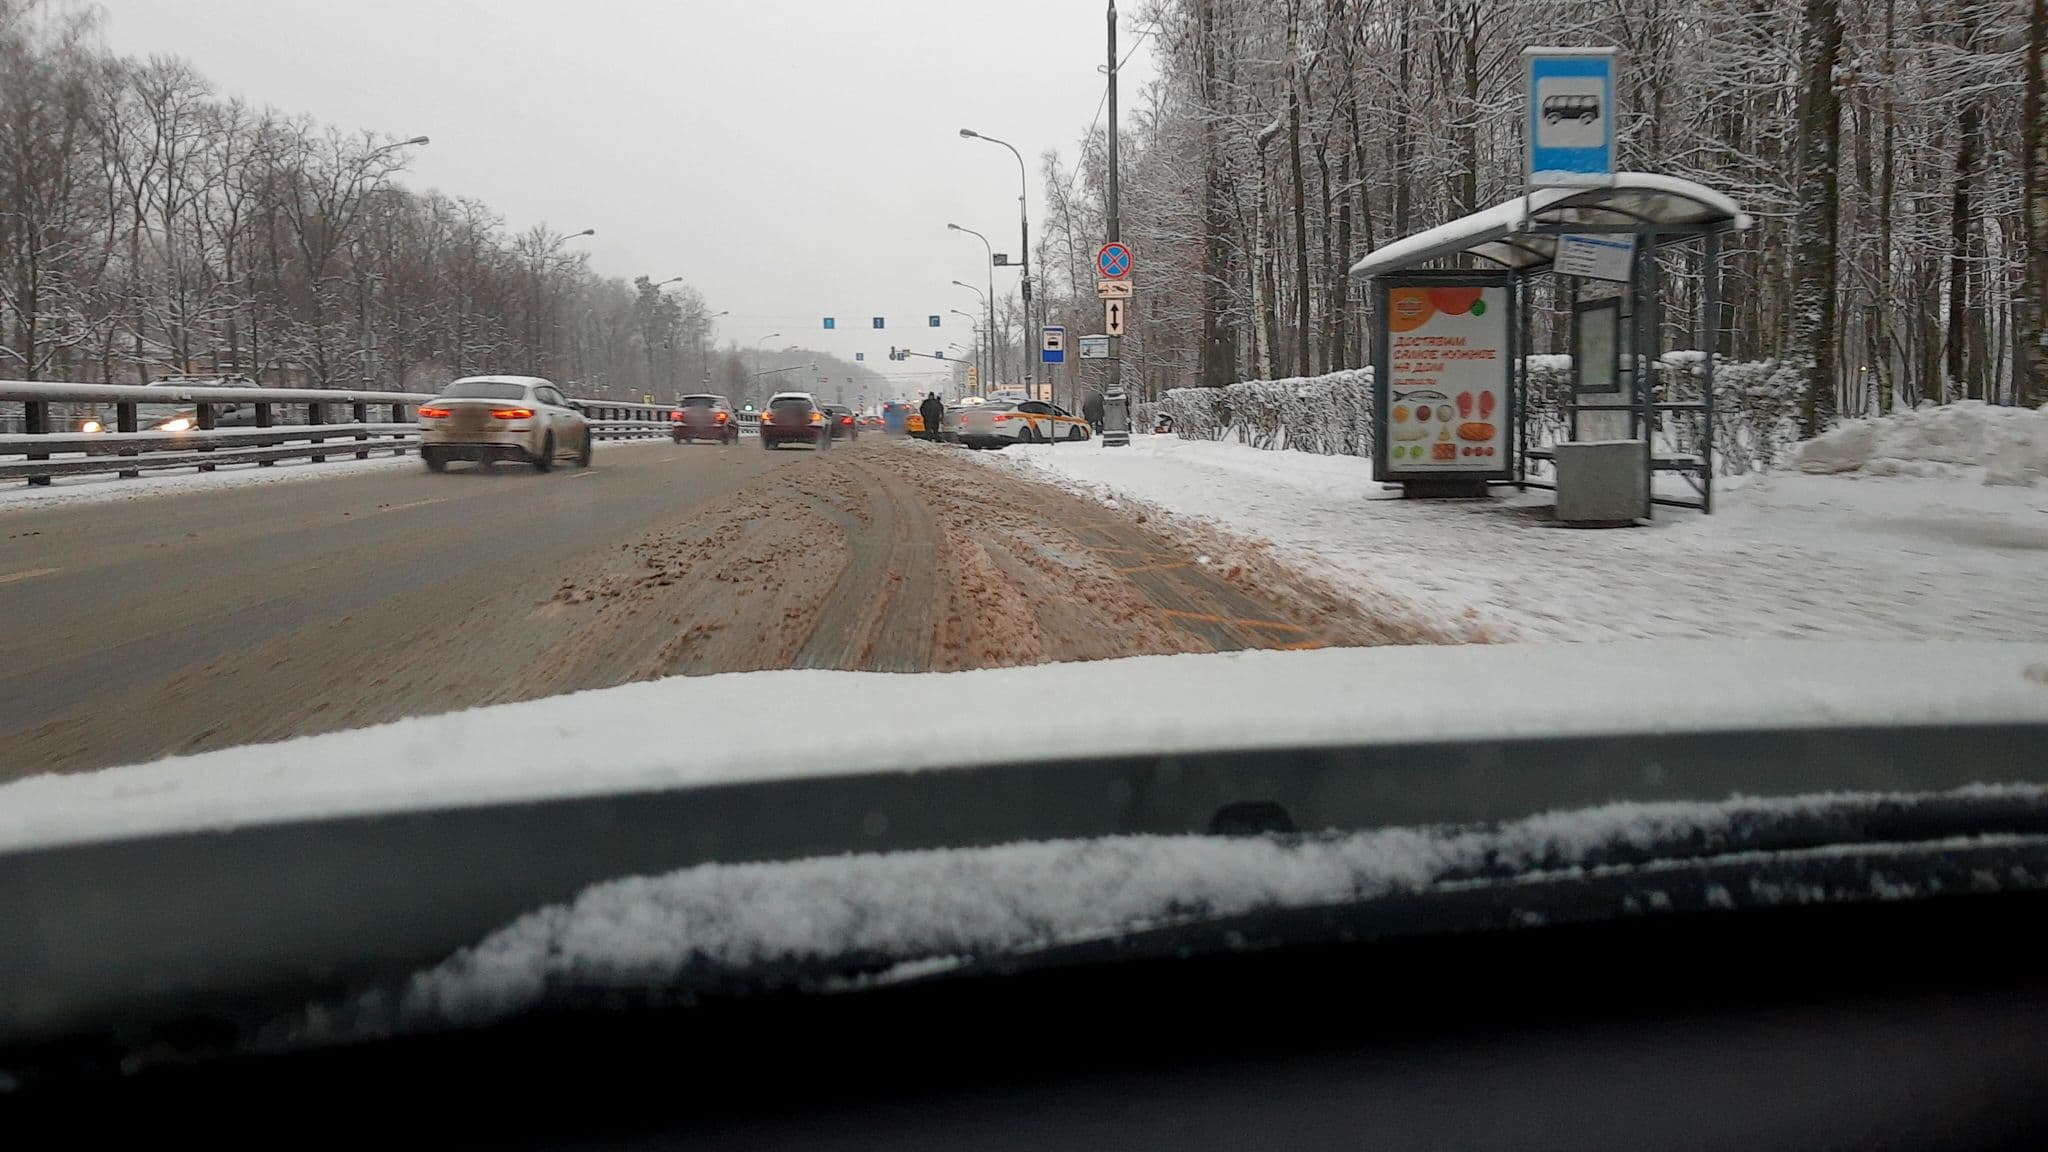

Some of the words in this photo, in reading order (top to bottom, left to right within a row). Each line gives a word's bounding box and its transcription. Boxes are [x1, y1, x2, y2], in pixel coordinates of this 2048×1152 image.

[1393, 349, 1439, 360] САМОЕ
[1441, 349, 1496, 360] НУЖНОЕ
[1393, 362, 1410, 371] НА
[1412, 362, 1444, 373] ДОМ
